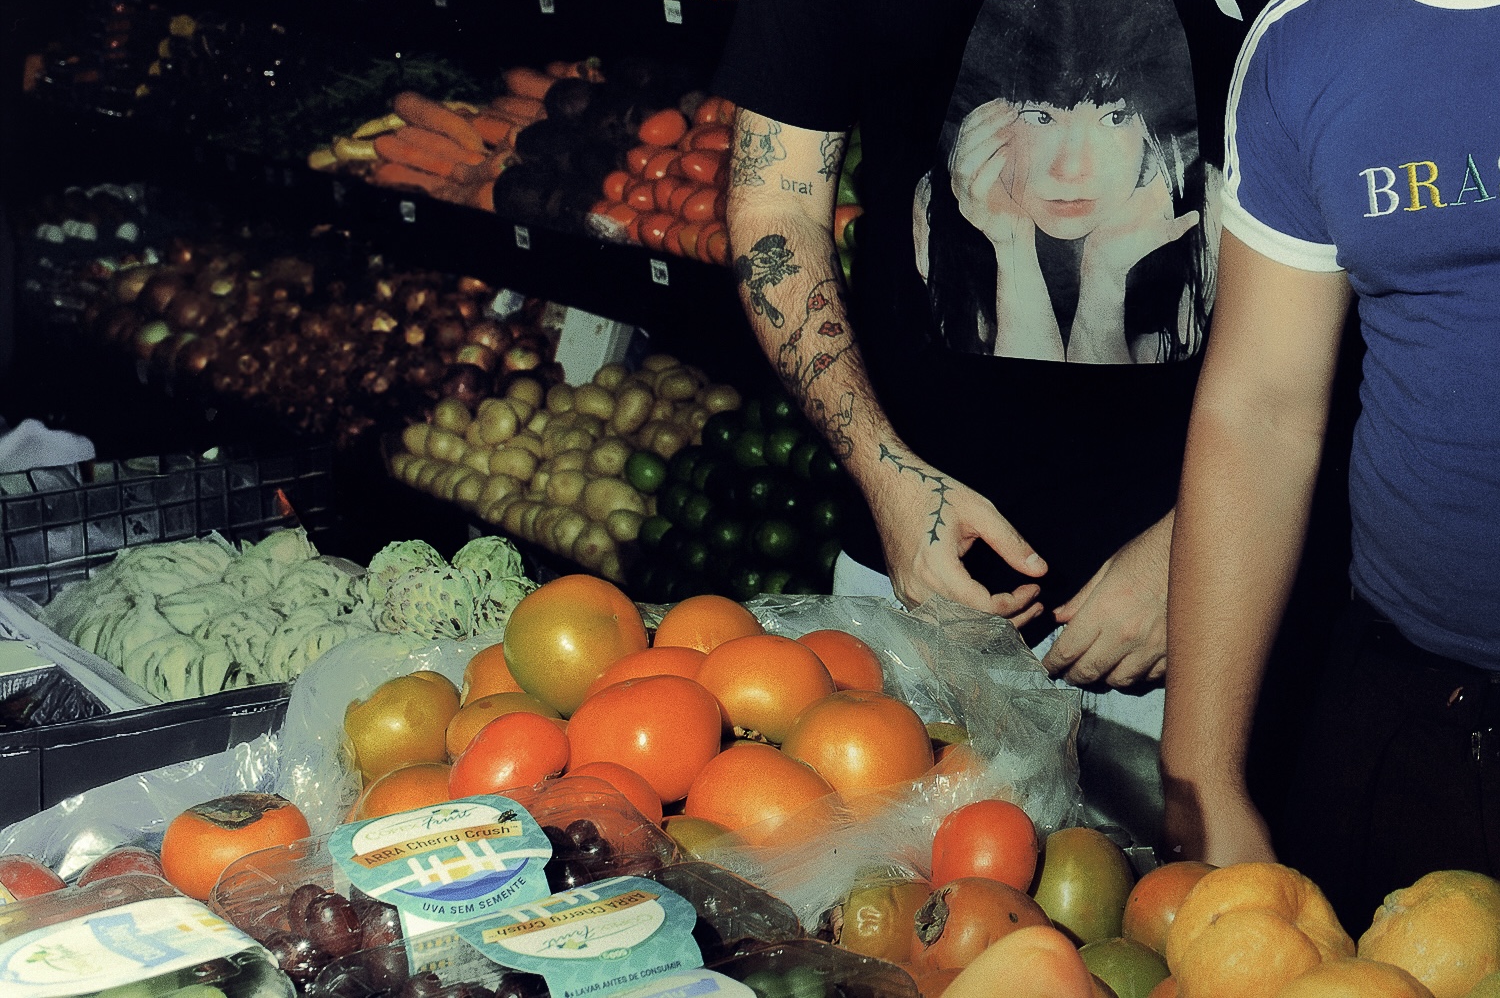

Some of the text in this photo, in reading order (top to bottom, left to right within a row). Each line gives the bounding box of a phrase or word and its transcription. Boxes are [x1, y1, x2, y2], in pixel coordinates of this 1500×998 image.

[779, 174, 814, 196] brat
[364, 847, 406, 866] ARRA
[406, 831, 461, 852] Cherry
[422, 875, 528, 916] UVA SEM SEMENTE
[604, 891, 647, 912] ARRA
[548, 905, 606, 927] Cherry
[574, 959, 682, 997] LAVAR ANTES DE CONSUMIR
